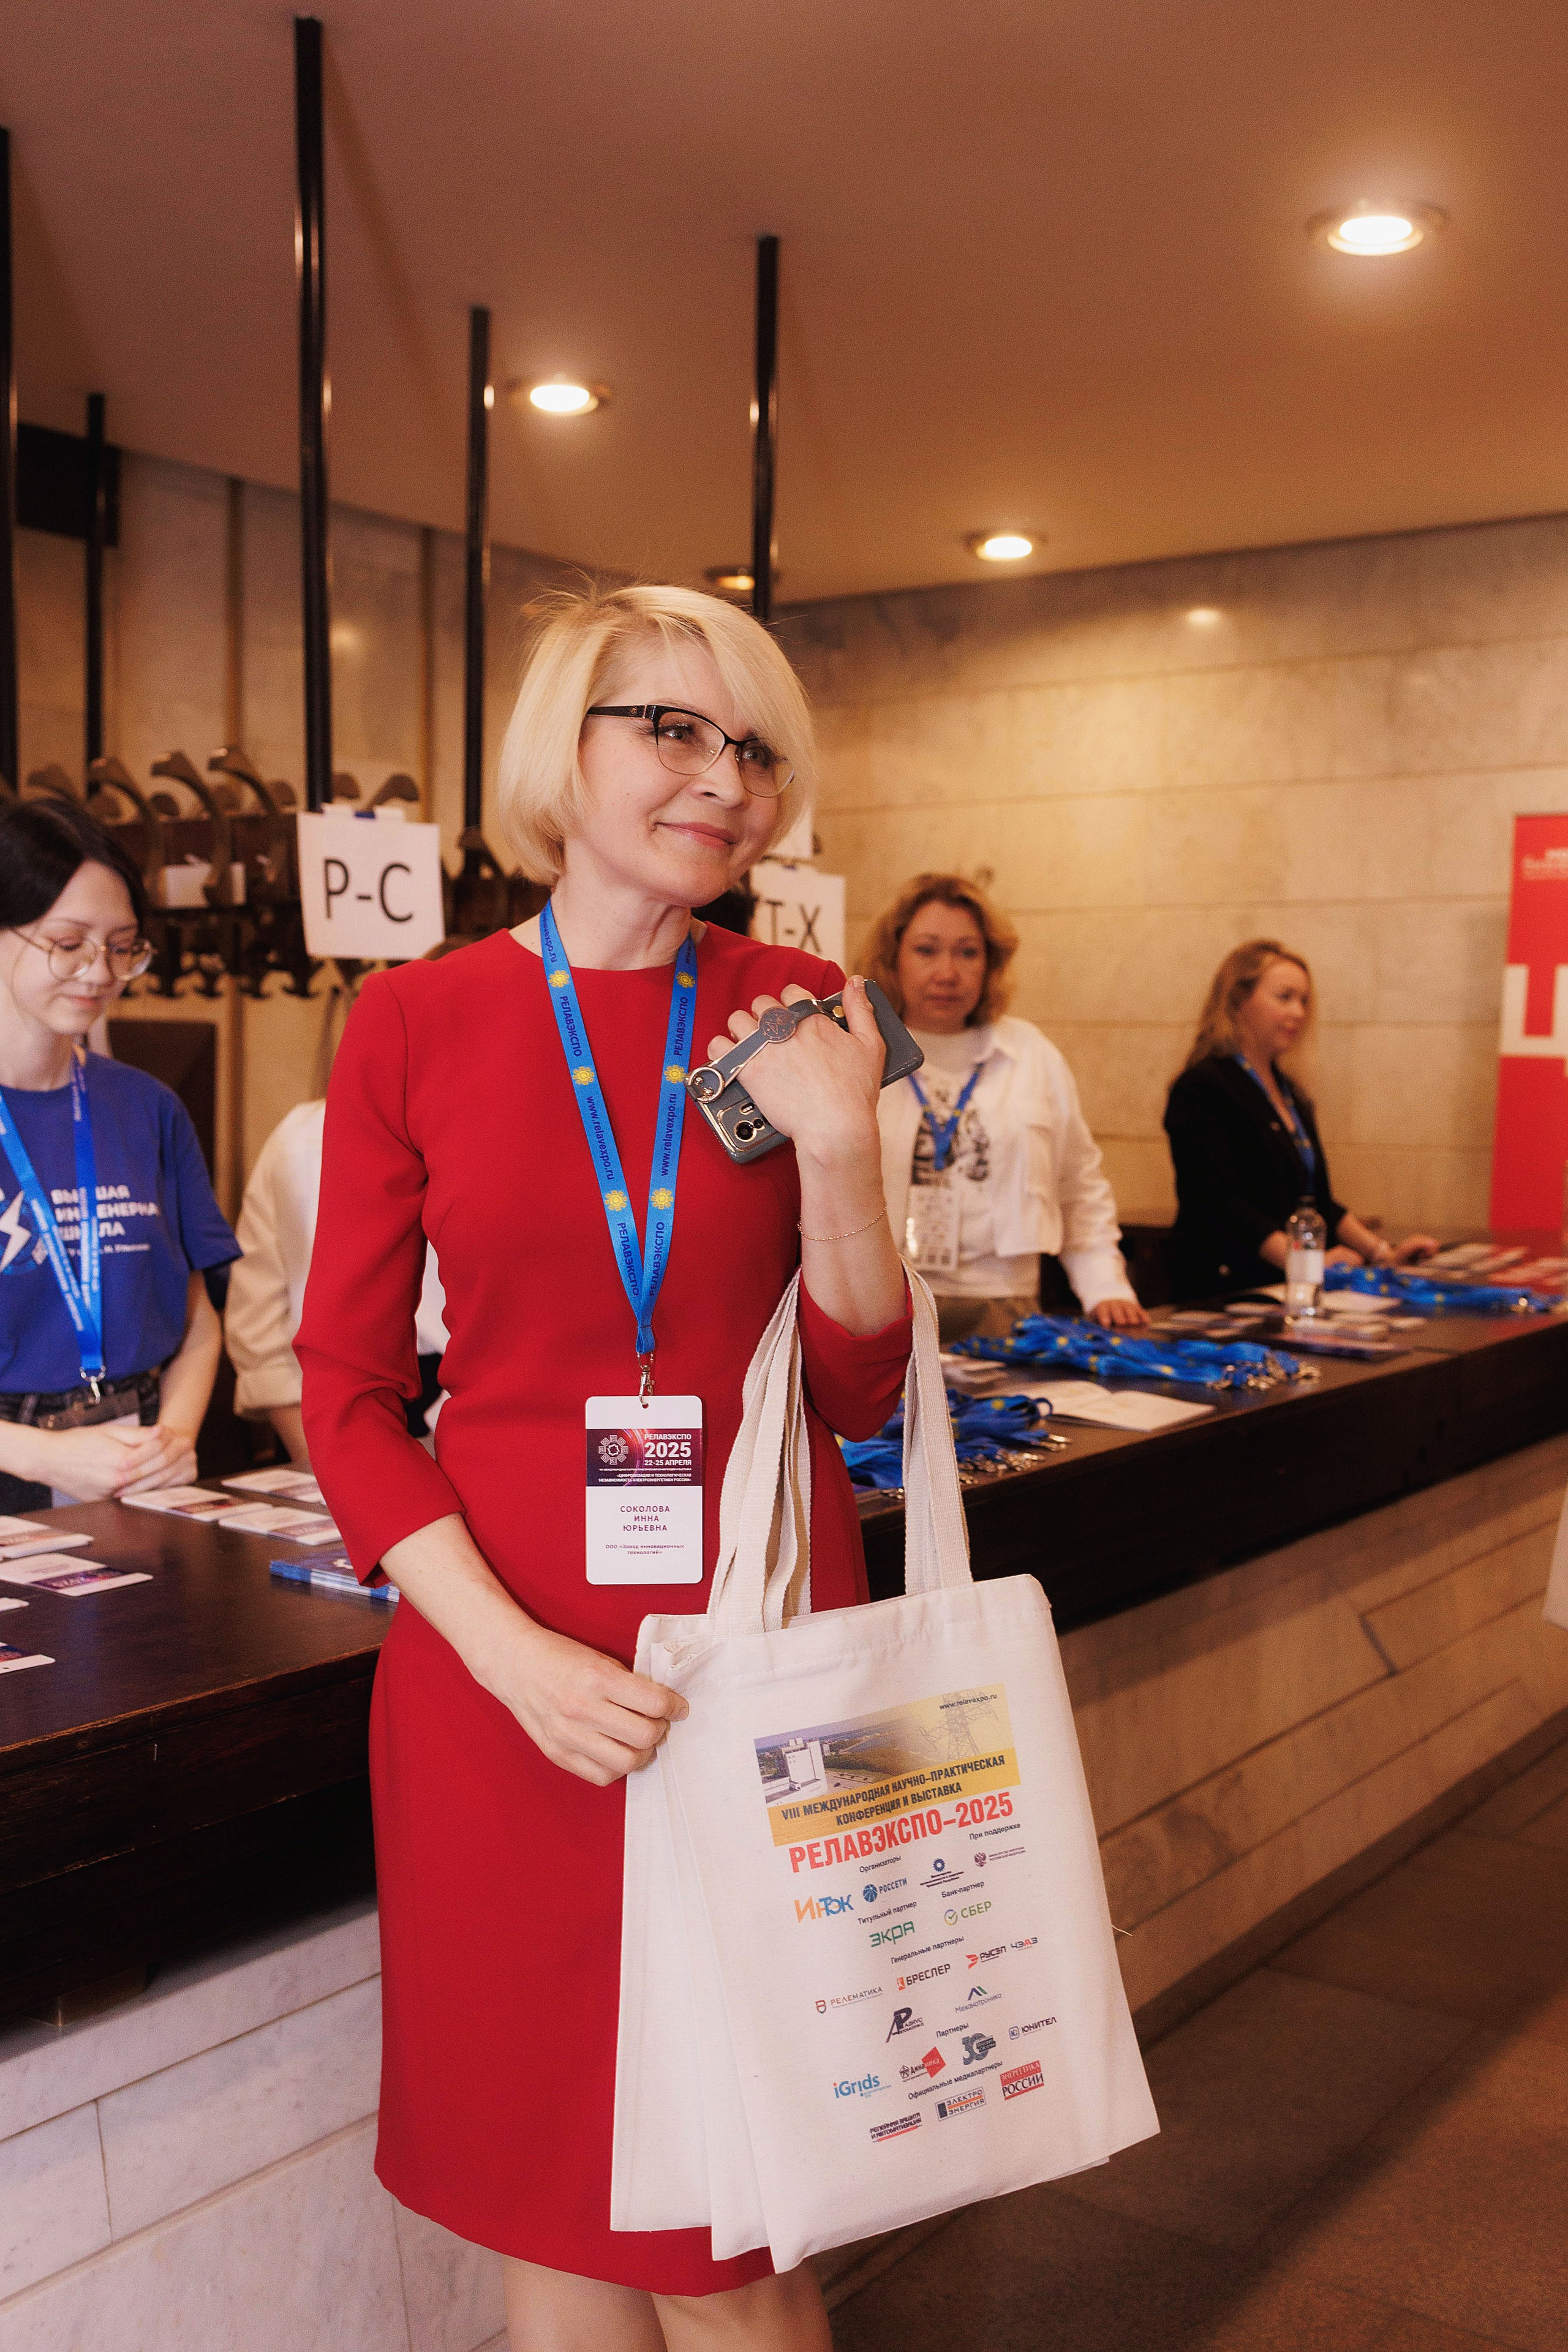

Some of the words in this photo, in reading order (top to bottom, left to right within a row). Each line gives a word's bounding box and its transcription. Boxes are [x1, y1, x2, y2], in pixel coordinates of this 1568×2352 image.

[560, 995, 582, 1057] РЕЛАВЭКСПО
[674, 997, 688, 1056] РЕЛАВЭКСПО
[586, 1096, 614, 1180] www.relavexpo.ru
[661, 1093, 677, 1176] www.relavexpo.ru
[617, 1222, 639, 1296] РЕЛАВЭКСПО
[649, 1222, 665, 1297] РЕЛАВЭКСПО
[644, 1442, 692, 1458] 2025
[939, 1693, 997, 1710] www.relavexpo.ru
[781, 1806, 801, 1821] VIII
[804, 1785, 890, 1817] МЕЖДУНАРОДНАЯ
[835, 1798, 901, 1826] КОНФЕРЕНЦИЯ
[903, 1796, 910, 1809] И
[912, 1782, 962, 1805] ВЫСТАВКА
[969, 1832, 982, 1841] При
[984, 1823, 1021, 1837] поддержке
[859, 1856, 902, 1873] Организаторы
[879, 1878, 907, 1894] РОССЕТИ
[941, 1881, 984, 1898] Банк-партнер
[858, 1908, 892, 1925] Титульный
[893, 1901, 917, 1915] партнер
[961, 1901, 992, 1918] СБЕР
[891, 1946, 931, 1964] Генеральные
[933, 1936, 964, 1950] партнеры
[906, 1964, 951, 1986] БРЕСЛЕР
[831, 1986, 883, 2006] РЕЛЕМАТИКА
[955, 1992, 1002, 2013] Механотроника
[937, 2023, 969, 2038] Партнеры
[1021, 2017, 1057, 2034] ЮНИТЕЛ
[908, 2079, 953, 2100] Официальные
[954, 2061, 1003, 2083] медиапартнеры
[1001, 2062, 1041, 2082] ЭНЕРГЕТИКА
[1001, 2073, 1044, 2097] РОССИИ
[946, 2089, 983, 2106] ЭЛЕКТРО
[948, 2098, 985, 2115] ЭНЕРГИЯ
